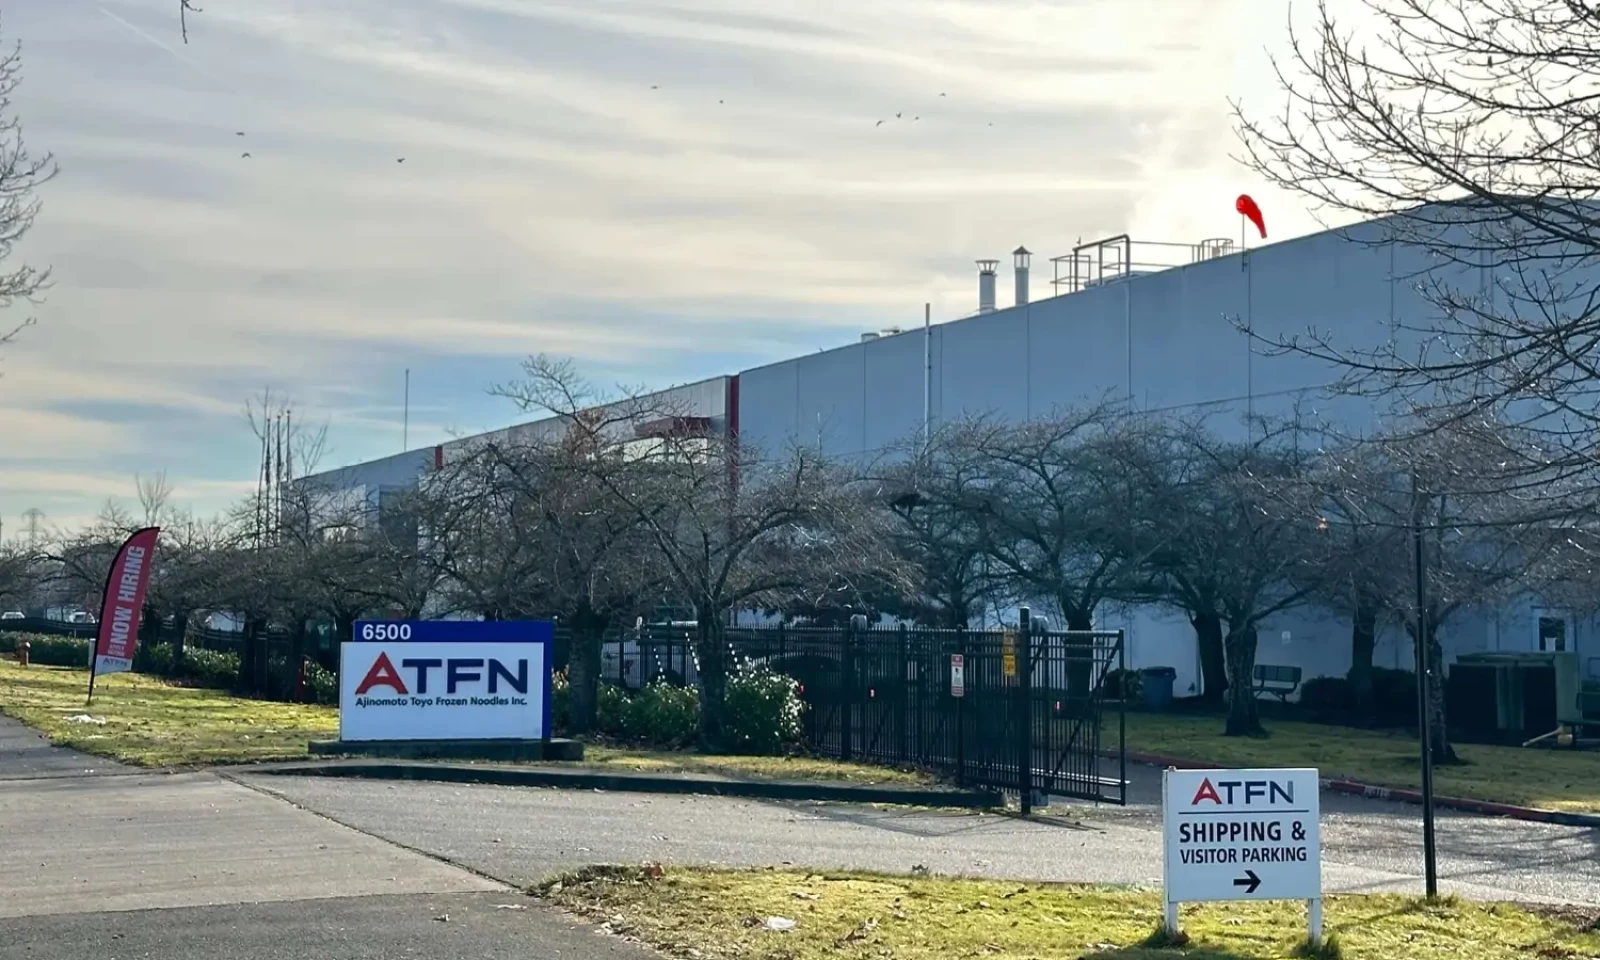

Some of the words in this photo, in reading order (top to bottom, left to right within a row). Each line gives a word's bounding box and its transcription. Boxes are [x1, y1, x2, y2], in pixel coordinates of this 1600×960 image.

[118, 546, 145, 602] HIRING
[110, 606, 132, 645] NOW
[363, 624, 412, 640] 6500
[355, 651, 528, 694] ATFN
[355, 697, 408, 708] Ajinomoto
[410, 697, 433, 708] Toyo
[436, 697, 467, 706] Frozen
[471, 696, 509, 706] Noodles
[511, 696, 528, 706] Inc.
[1191, 777, 1294, 805] ATFN
[1179, 821, 1281, 843] SHIPPING
[1291, 821, 1306, 841] &
[1180, 848, 1237, 864] VISITOR
[1242, 847, 1307, 863] PARKING
